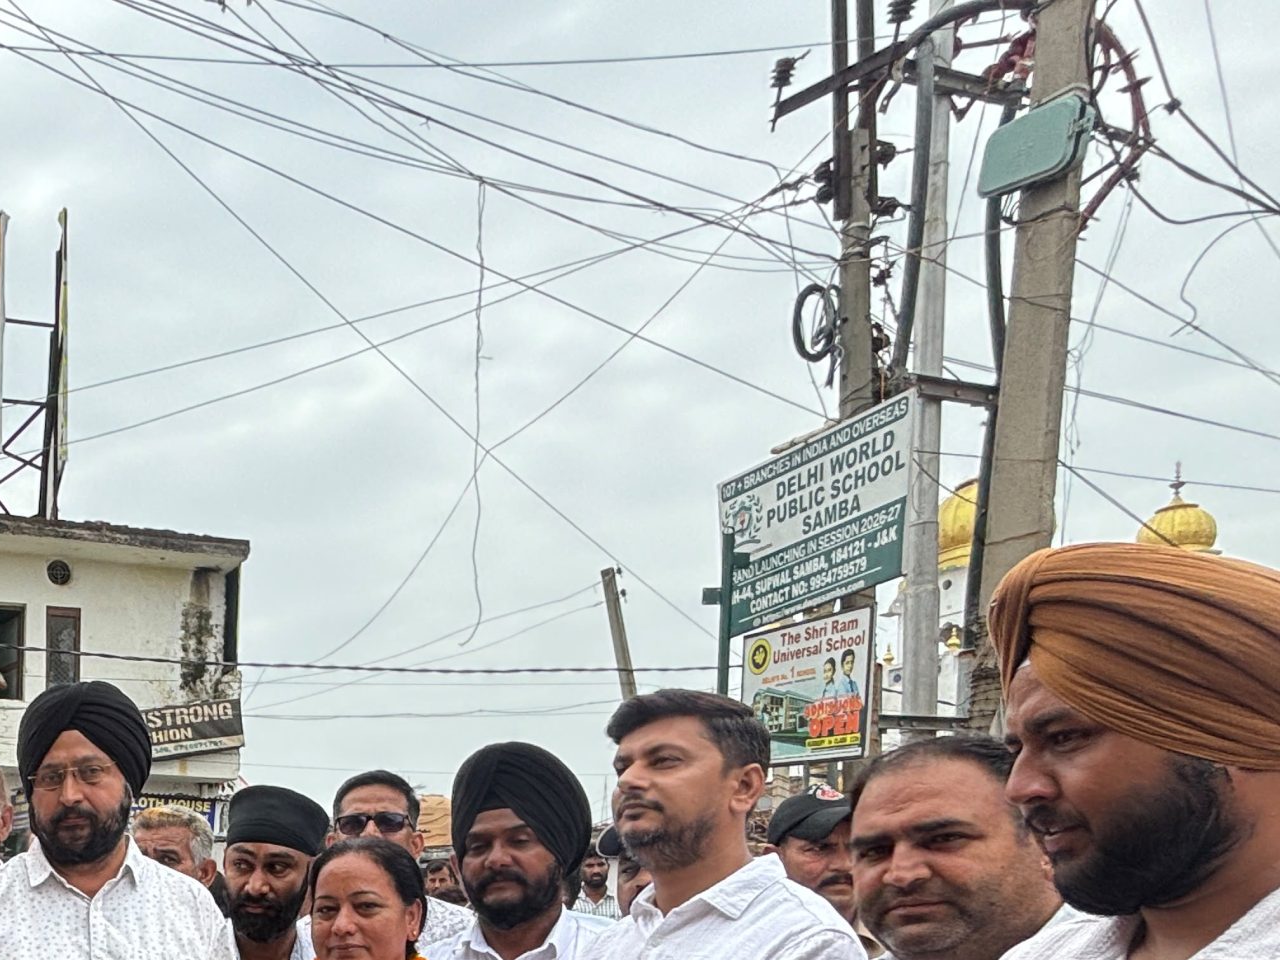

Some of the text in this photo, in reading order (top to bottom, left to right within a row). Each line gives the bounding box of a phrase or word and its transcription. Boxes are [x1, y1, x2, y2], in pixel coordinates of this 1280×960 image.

[743, 456, 791, 489] BRANCHES
[791, 451, 801, 467] IN
[802, 439, 828, 462] INDIA
[829, 428, 851, 449] AND
[851, 399, 908, 438] OVERSEAS
[776, 430, 895, 501] DELHI WORLD
[767, 450, 905, 528] PUBLIC SCHOOL
[802, 494, 861, 535] SAMBA
[754, 544, 806, 575] LAUNCHING
[806, 539, 817, 553] IN
[818, 521, 860, 550] SESSION
[860, 503, 902, 533] 2026-27
[873, 525, 898, 548] J&K
[750, 586, 791, 614] CONTACT
[791, 579, 809, 598] NO:
[773, 631, 866, 664] Universal School
[780, 618, 859, 647] The Shri Ram
[150, 727, 192, 743] HION
[809, 711, 861, 737] OPEN
[131, 797, 212, 812] LOTH HOUSE
